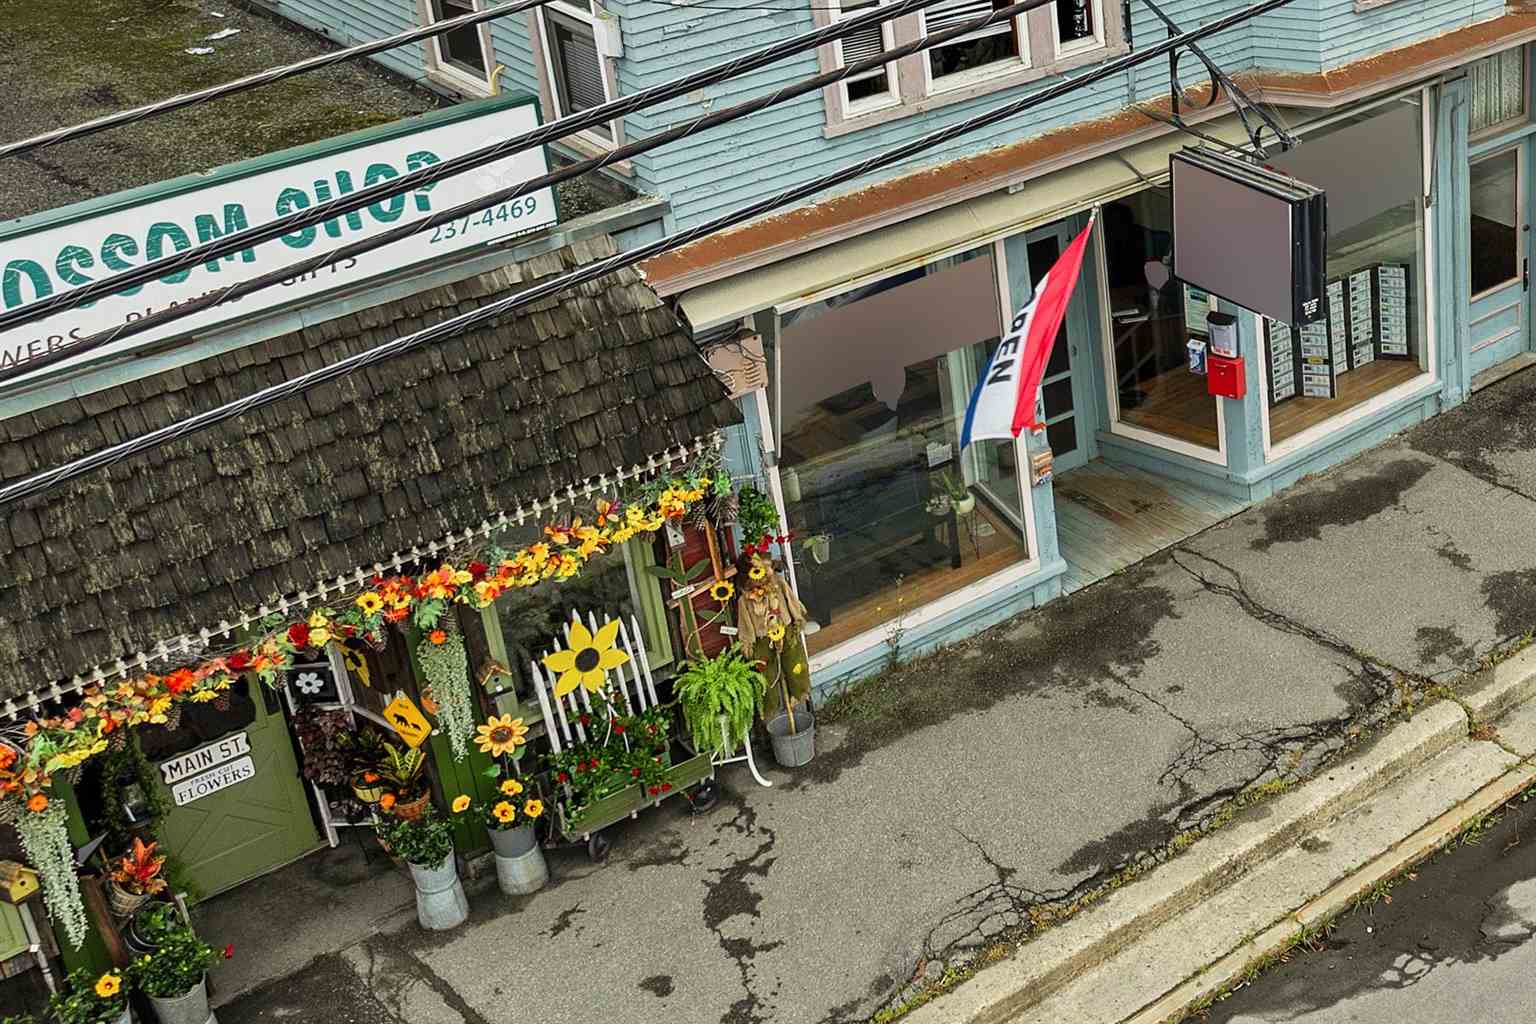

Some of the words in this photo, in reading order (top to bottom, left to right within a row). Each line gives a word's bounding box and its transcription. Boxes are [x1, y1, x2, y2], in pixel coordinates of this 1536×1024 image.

[275, 151, 441, 248] SHOP
[429, 196, 537, 244] 237-4469
[988, 288, 1037, 386] PEN
[167, 749, 213, 779] MAIN
[178, 764, 251, 802] FLOWERS
